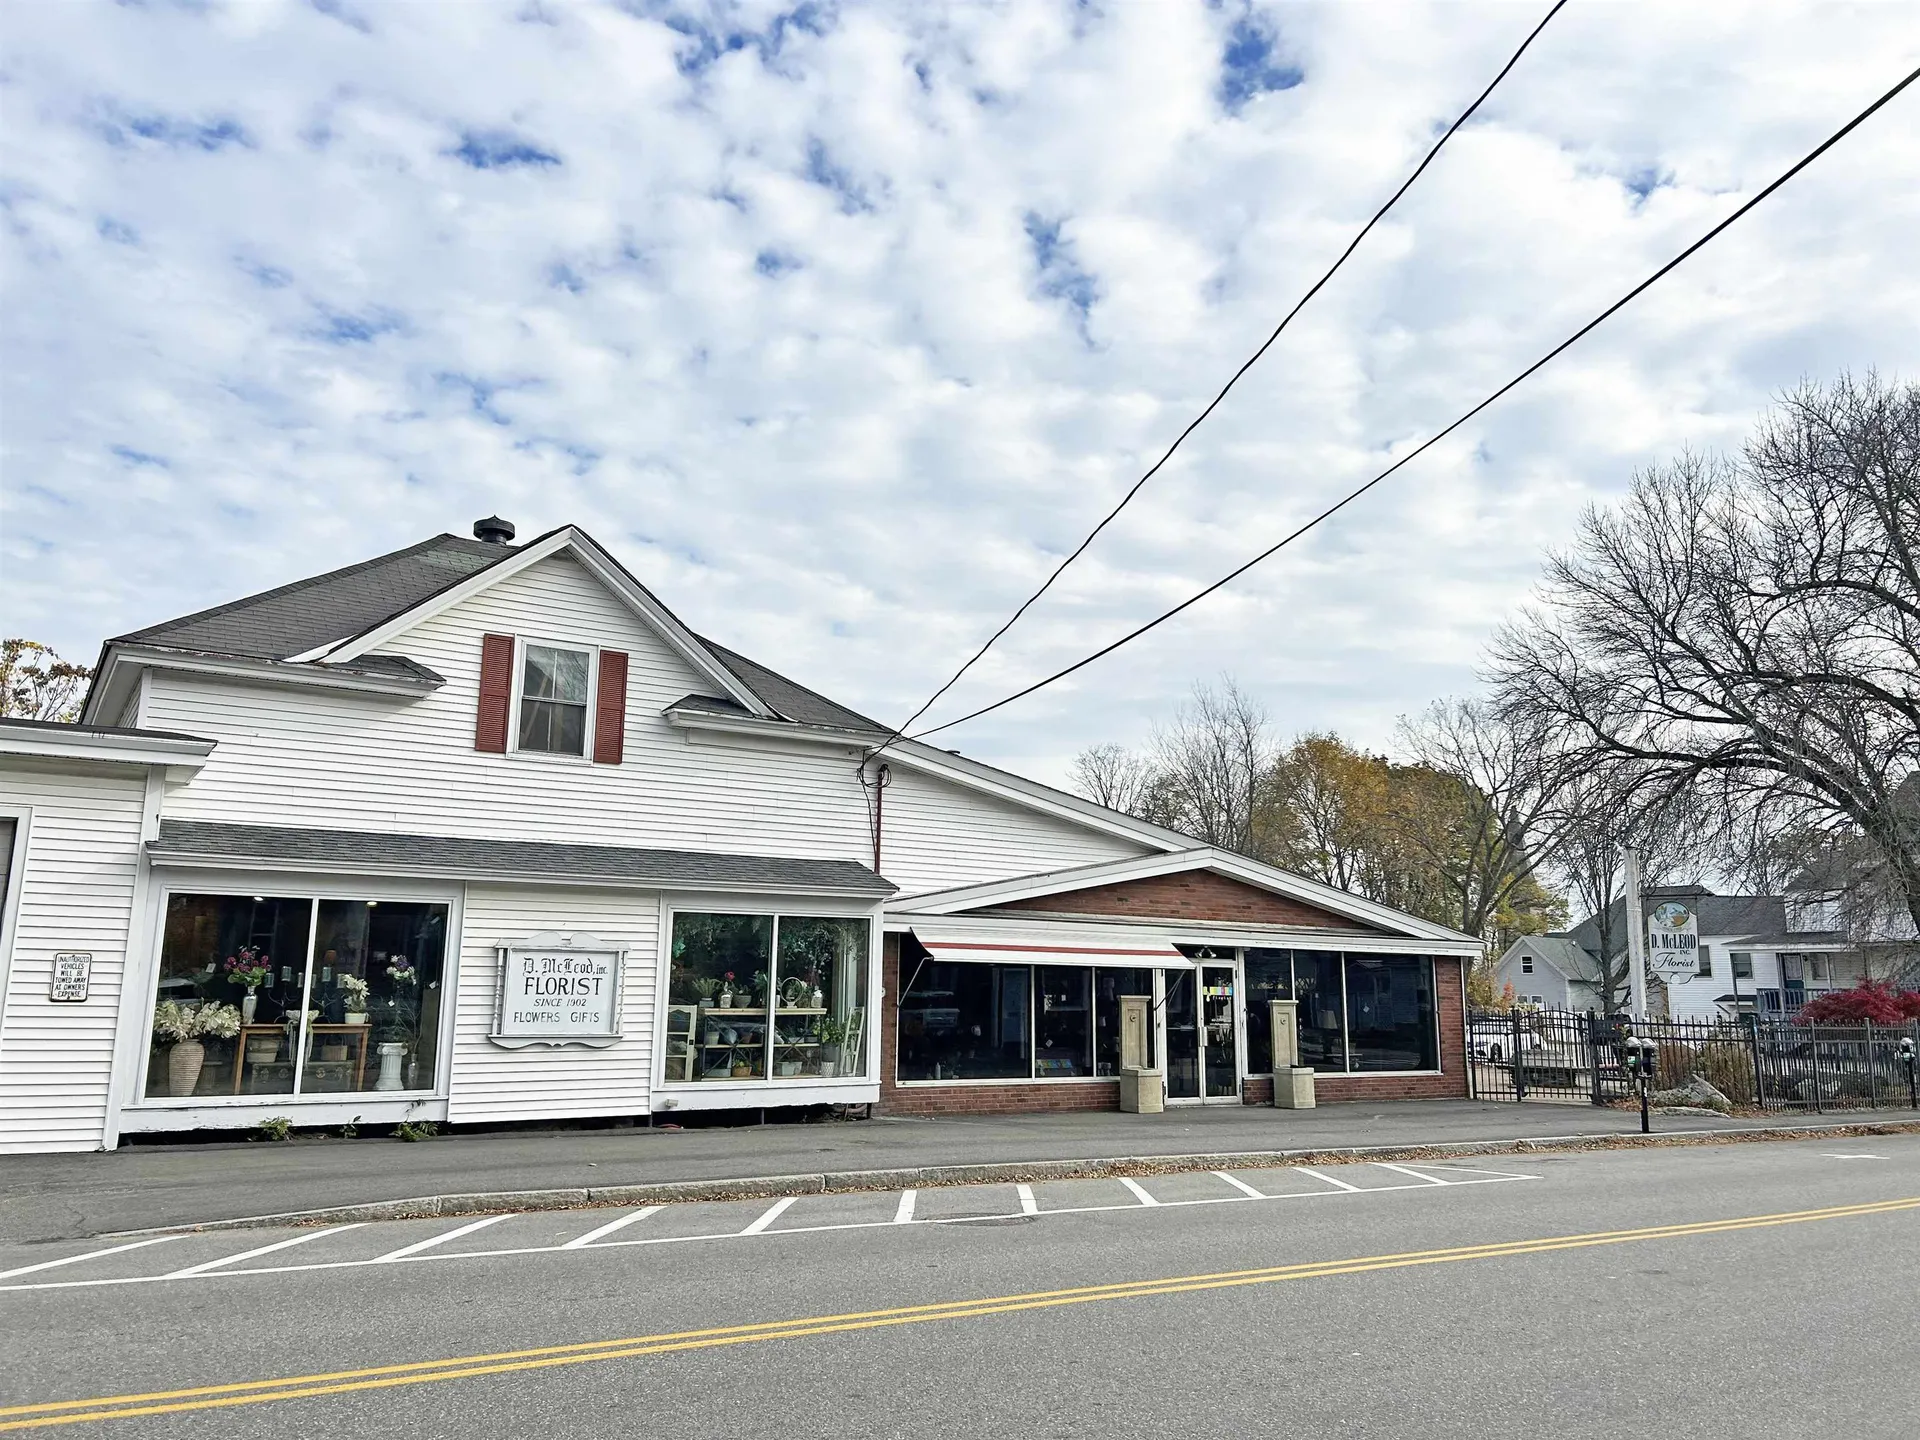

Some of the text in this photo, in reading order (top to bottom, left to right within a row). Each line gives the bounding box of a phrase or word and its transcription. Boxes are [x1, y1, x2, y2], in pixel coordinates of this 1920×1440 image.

[1651, 934, 1696, 949] D. McLEOD
[523, 957, 538, 977] D.
[1652, 952, 1694, 969] Florist
[524, 977, 603, 996] FLORIST
[533, 998, 587, 1007] SINCE 1902
[513, 1011, 600, 1023] FLOWERS GIFTS
